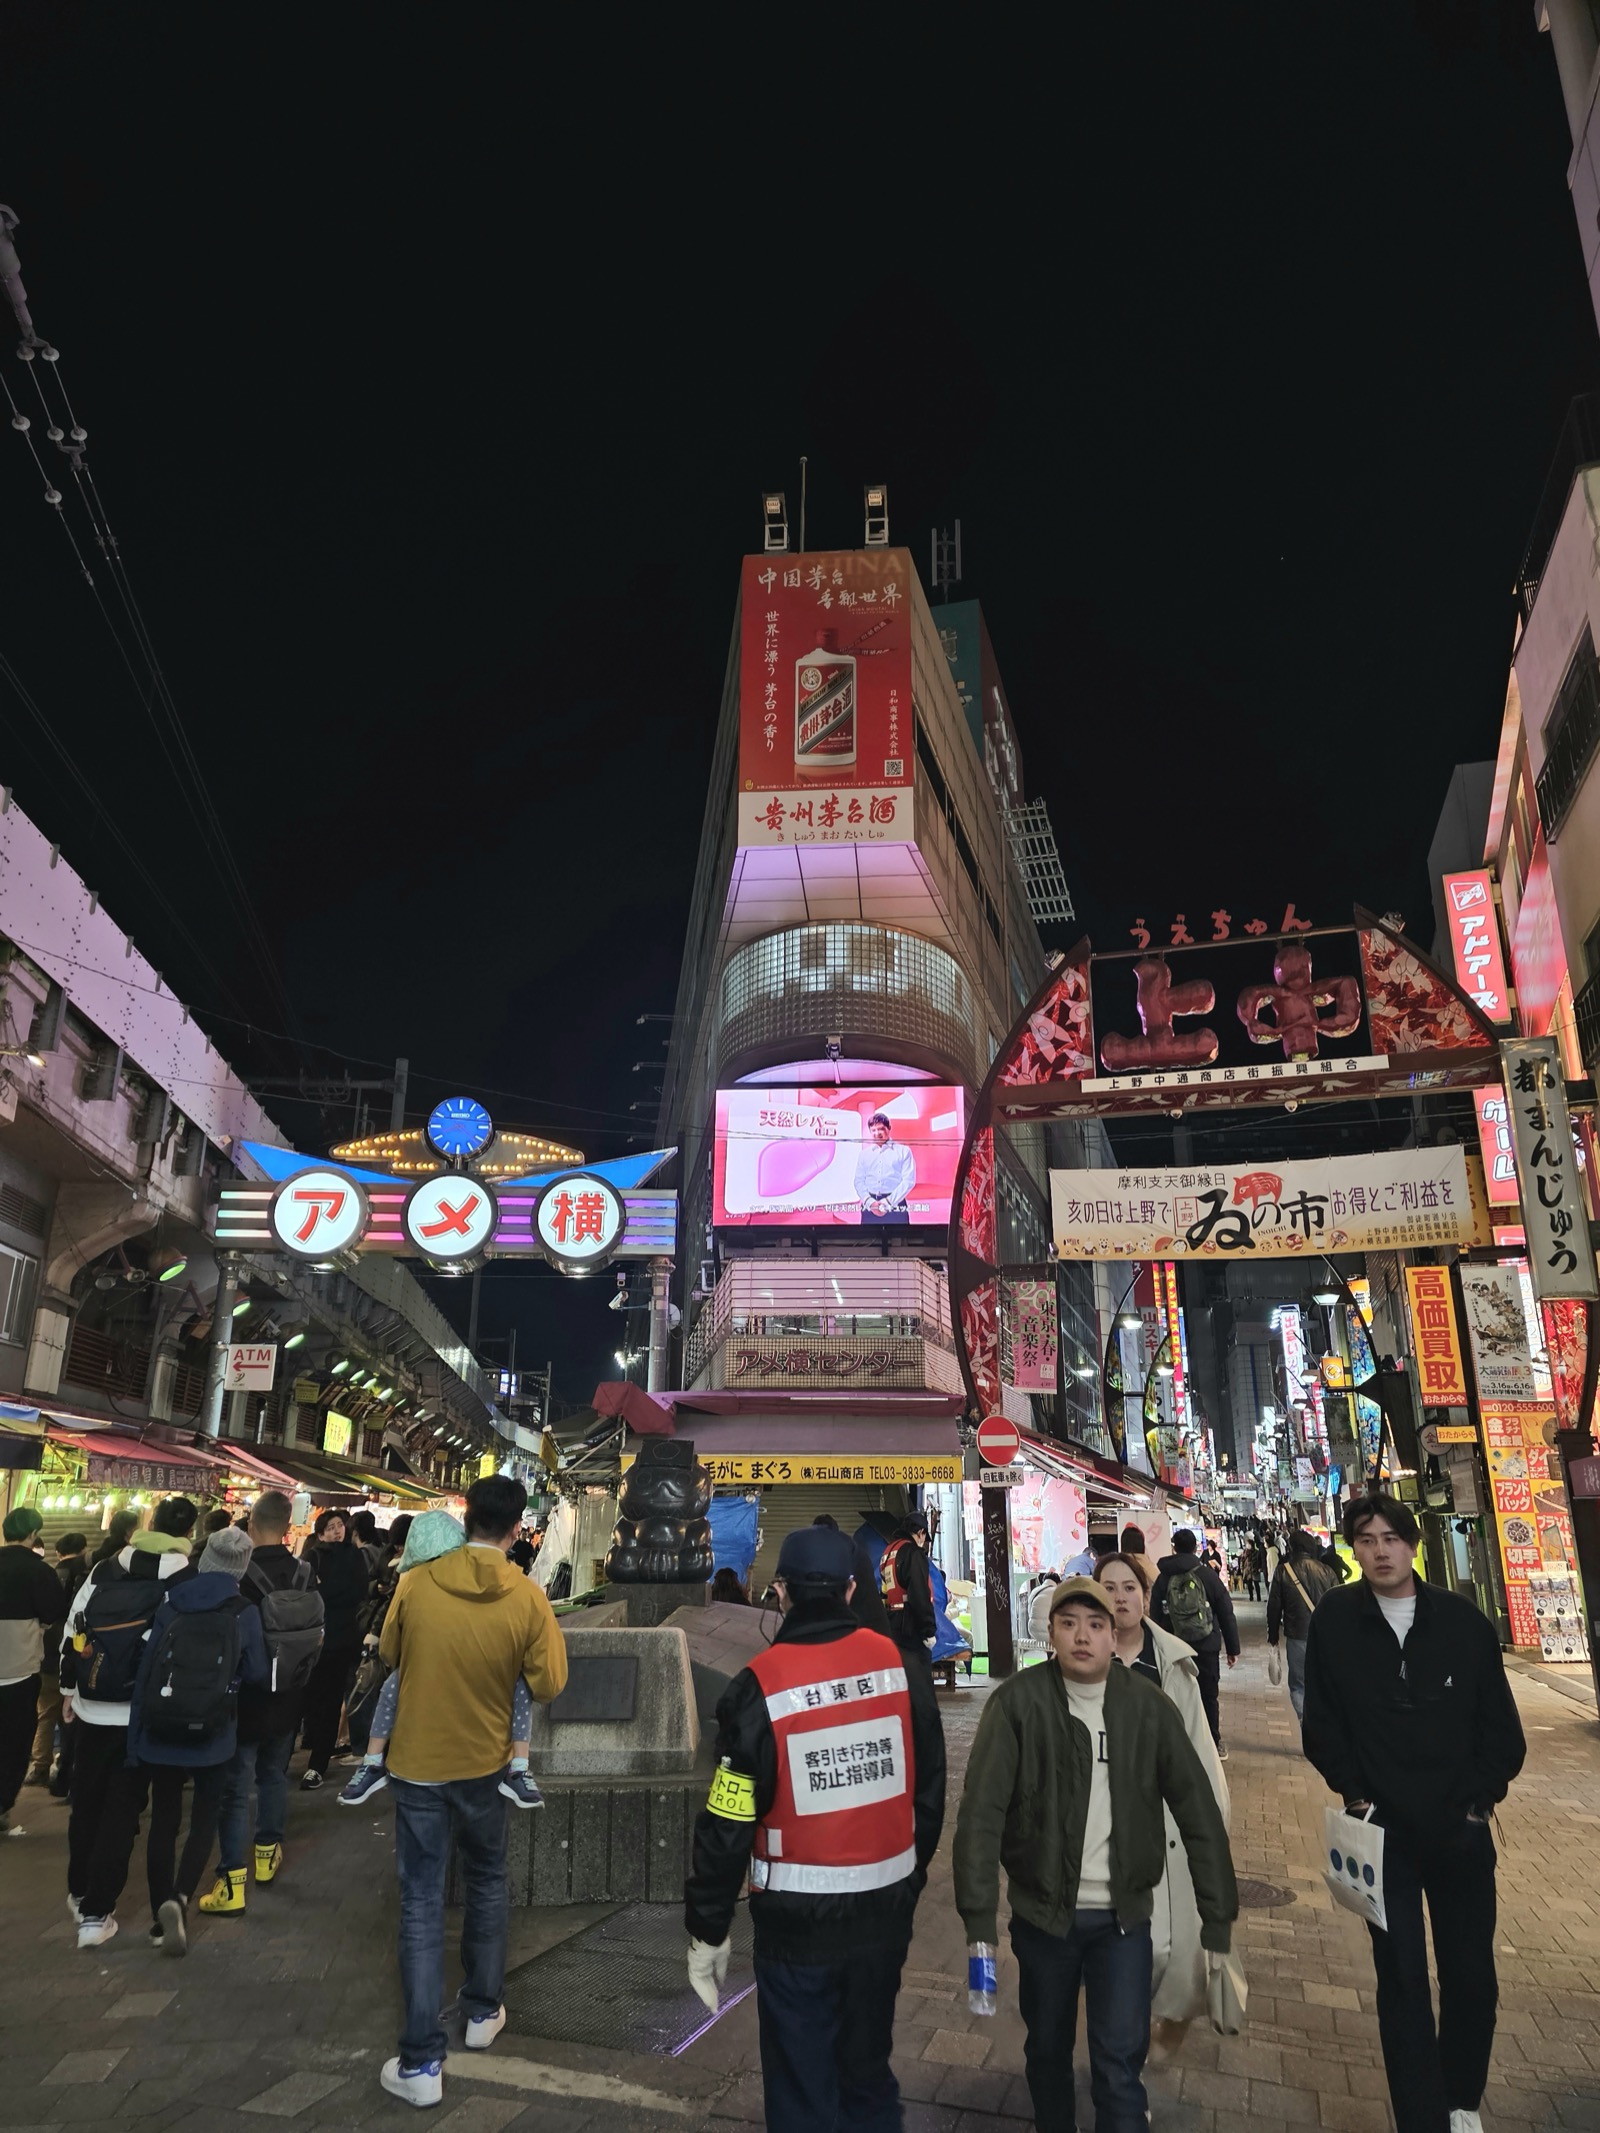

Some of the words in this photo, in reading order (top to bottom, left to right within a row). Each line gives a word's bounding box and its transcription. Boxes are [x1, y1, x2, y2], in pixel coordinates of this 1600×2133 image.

[758, 565, 844, 594] 中国茅台
[764, 610, 779, 677] 世界に漂う
[763, 682, 778, 753] 茅台の香り
[888, 689, 899, 757] 日和商事株式会社
[1130, 903, 1312, 949] うえちゅん
[1459, 915, 1499, 1010] アドアーズ
[1101, 945, 1362, 1073] 上中
[1109, 1059, 1358, 1090] 上野中通商店街振興組合
[759, 1110, 839, 1128] 天然レバー
[1512, 1056, 1578, 1275] 都まんじゅう
[1117, 1172, 1226, 1190] 摩利支天御縁日
[1067, 1198, 1172, 1225] 亥の日は上野で
[1179, 1200, 1194, 1223] 上野
[1332, 1179, 1456, 1217] お得とご利益を
[291, 1187, 608, 1245] アメ横
[1406, 1212, 1457, 1224] 御徒町通り会
[1257, 1225, 1287, 1236] INOICHI
[1022, 1315, 1039, 1368] 音楽祭
[1412, 1269, 1459, 1390] 高価買取
[233, 1349, 271, 1361] ATM
[735, 1349, 917, 1376] アメ横センター
[1423, 1394, 1465, 1404] おたからや
[1491, 1402, 1555, 1412] 0120-555-600
[1438, 1430, 1476, 1439] おたからや
[1487, 1417, 1504, 1434] 金
[751, 1460, 792, 1480] まぐろ
[870, 1465, 954, 1481] TEL03-3833-6668
[983, 1471, 1022, 1484] 自転車を除く
[1496, 1481, 1529, 1496] ブランド
[1499, 1497, 1531, 1511] バッグ
[1506, 1548, 1540, 1565] 切手
[806, 1676, 875, 1707] 台東区
[804, 1737, 893, 1769] 客引き行為等
[809, 1757, 895, 1792] 防止指導員
